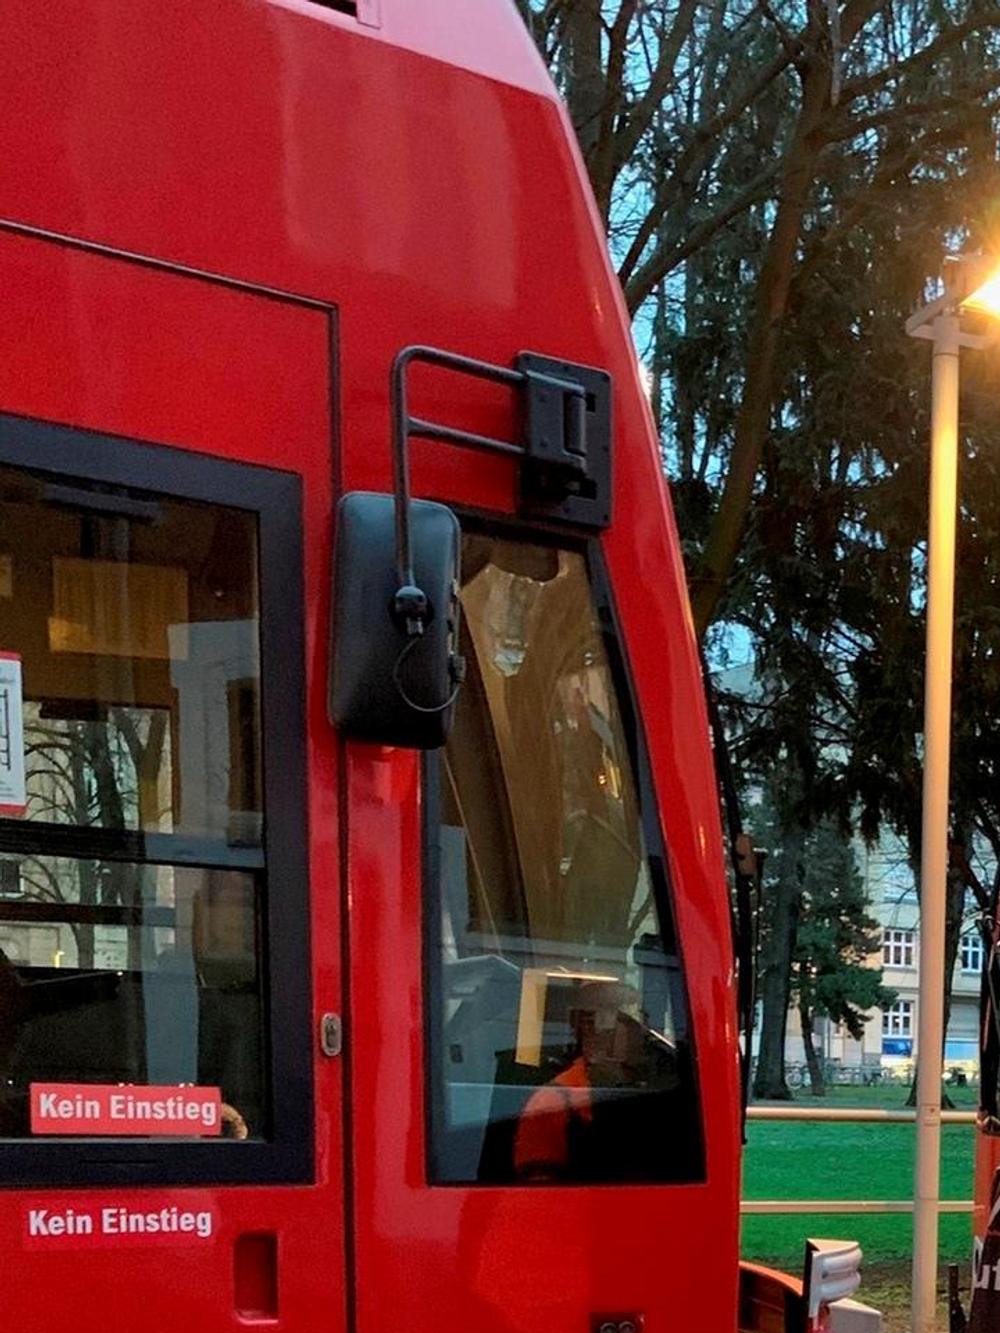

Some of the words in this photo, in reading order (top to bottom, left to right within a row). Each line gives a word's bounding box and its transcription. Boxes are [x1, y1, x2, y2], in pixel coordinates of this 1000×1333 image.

[39, 1093, 100, 1119] Kein
[109, 1094, 217, 1126] Einstieg
[28, 1209, 93, 1236] Kein
[102, 1207, 212, 1237] Einstieg
